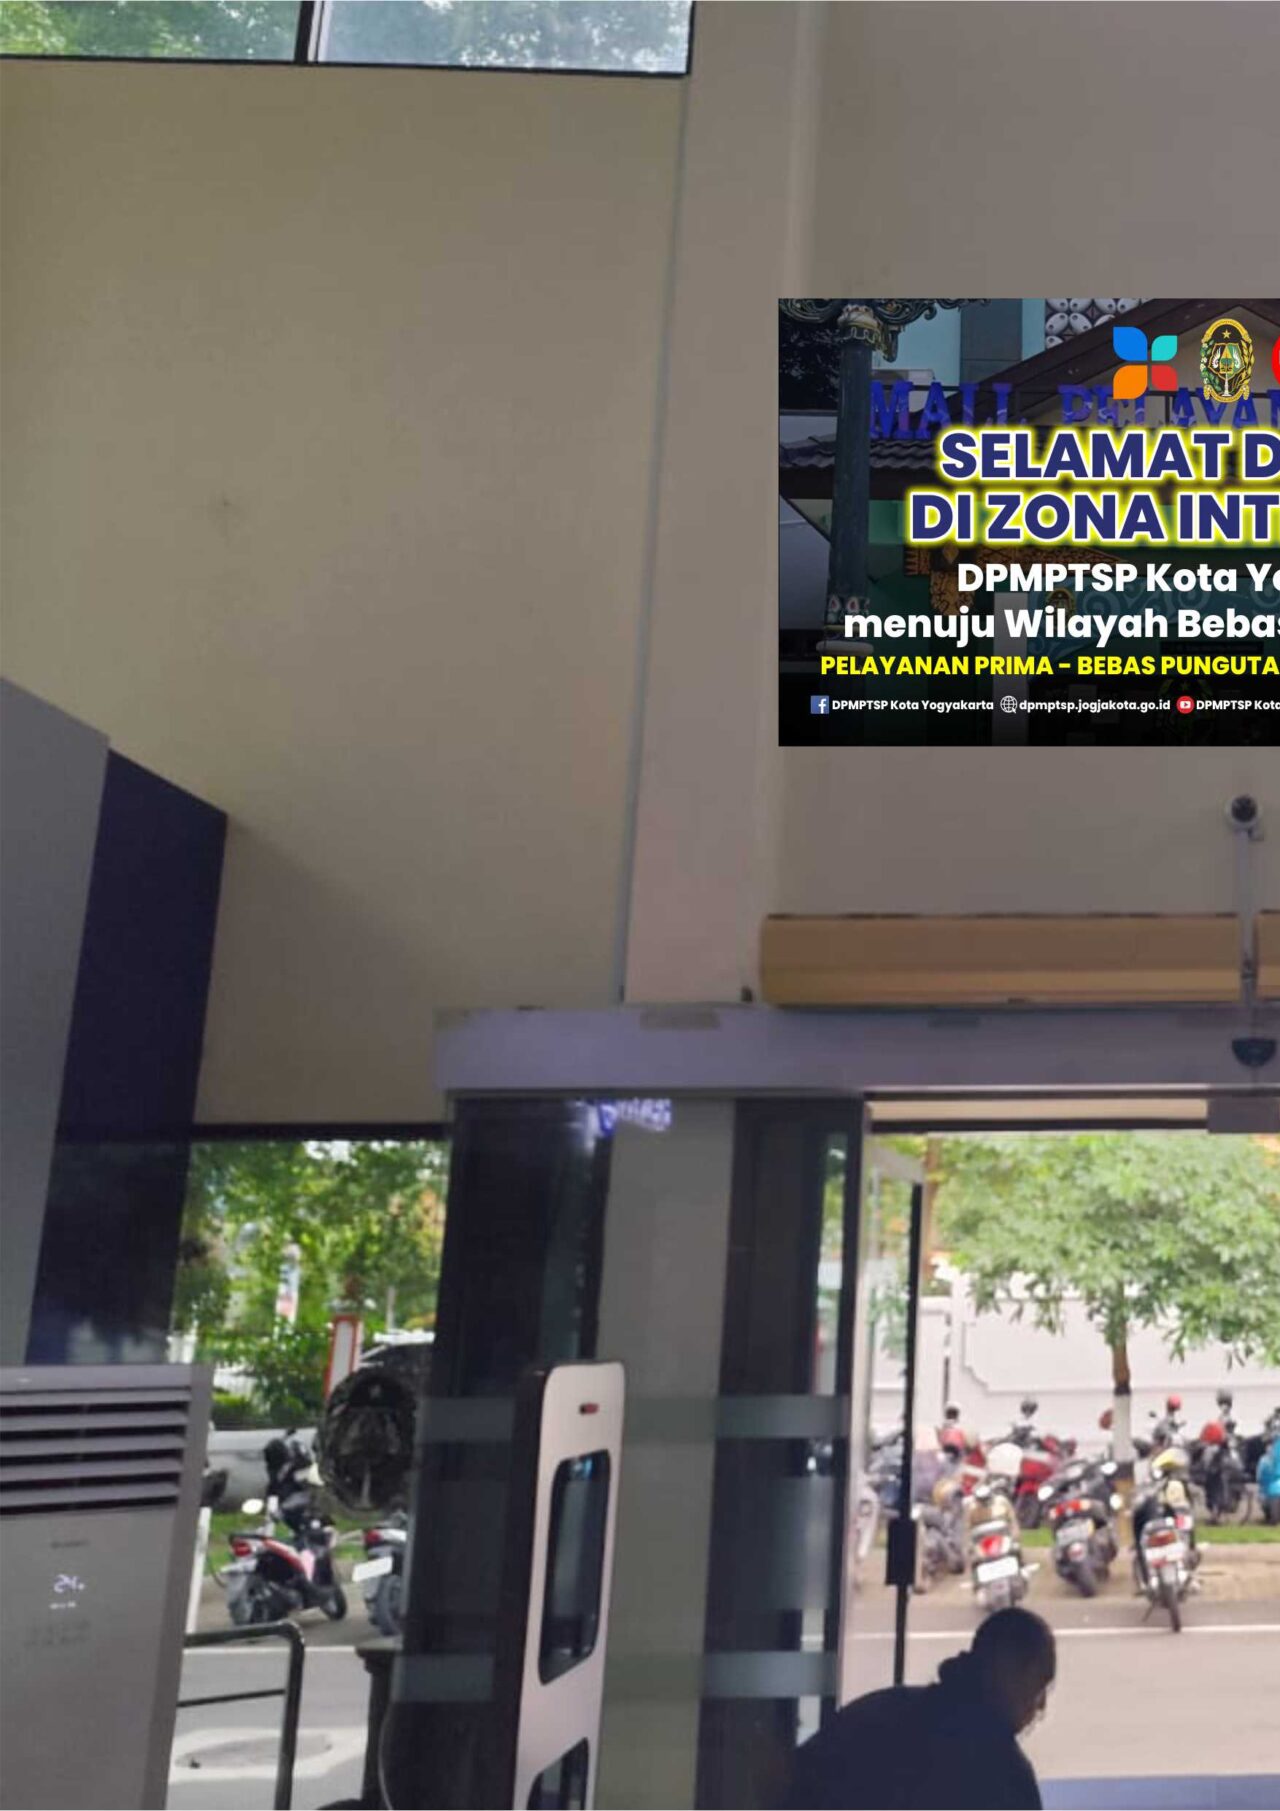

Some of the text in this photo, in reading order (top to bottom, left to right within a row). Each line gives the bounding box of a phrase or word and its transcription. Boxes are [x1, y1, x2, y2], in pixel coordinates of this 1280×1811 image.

[942, 432, 1230, 478] SELAMAT
[911, 494, 971, 540] DI
[988, 494, 1164, 540] ZONA
[958, 562, 1138, 592] DPMPTSP
[1146, 563, 1237, 592] Kota
[844, 605, 995, 648] menuju
[1003, 605, 1168, 648] Wilayah
[821, 656, 969, 675] PELAYANAN
[975, 656, 1054, 675] PRIMA
[1077, 655, 1156, 675] BEBAS
[832, 699, 994, 713] DPMPTSP Kota Yogyakarta
[1019, 699, 1171, 713] dpmptsp.jogjakota.go.id
[1196, 700, 1253, 710] DPMPTSP
